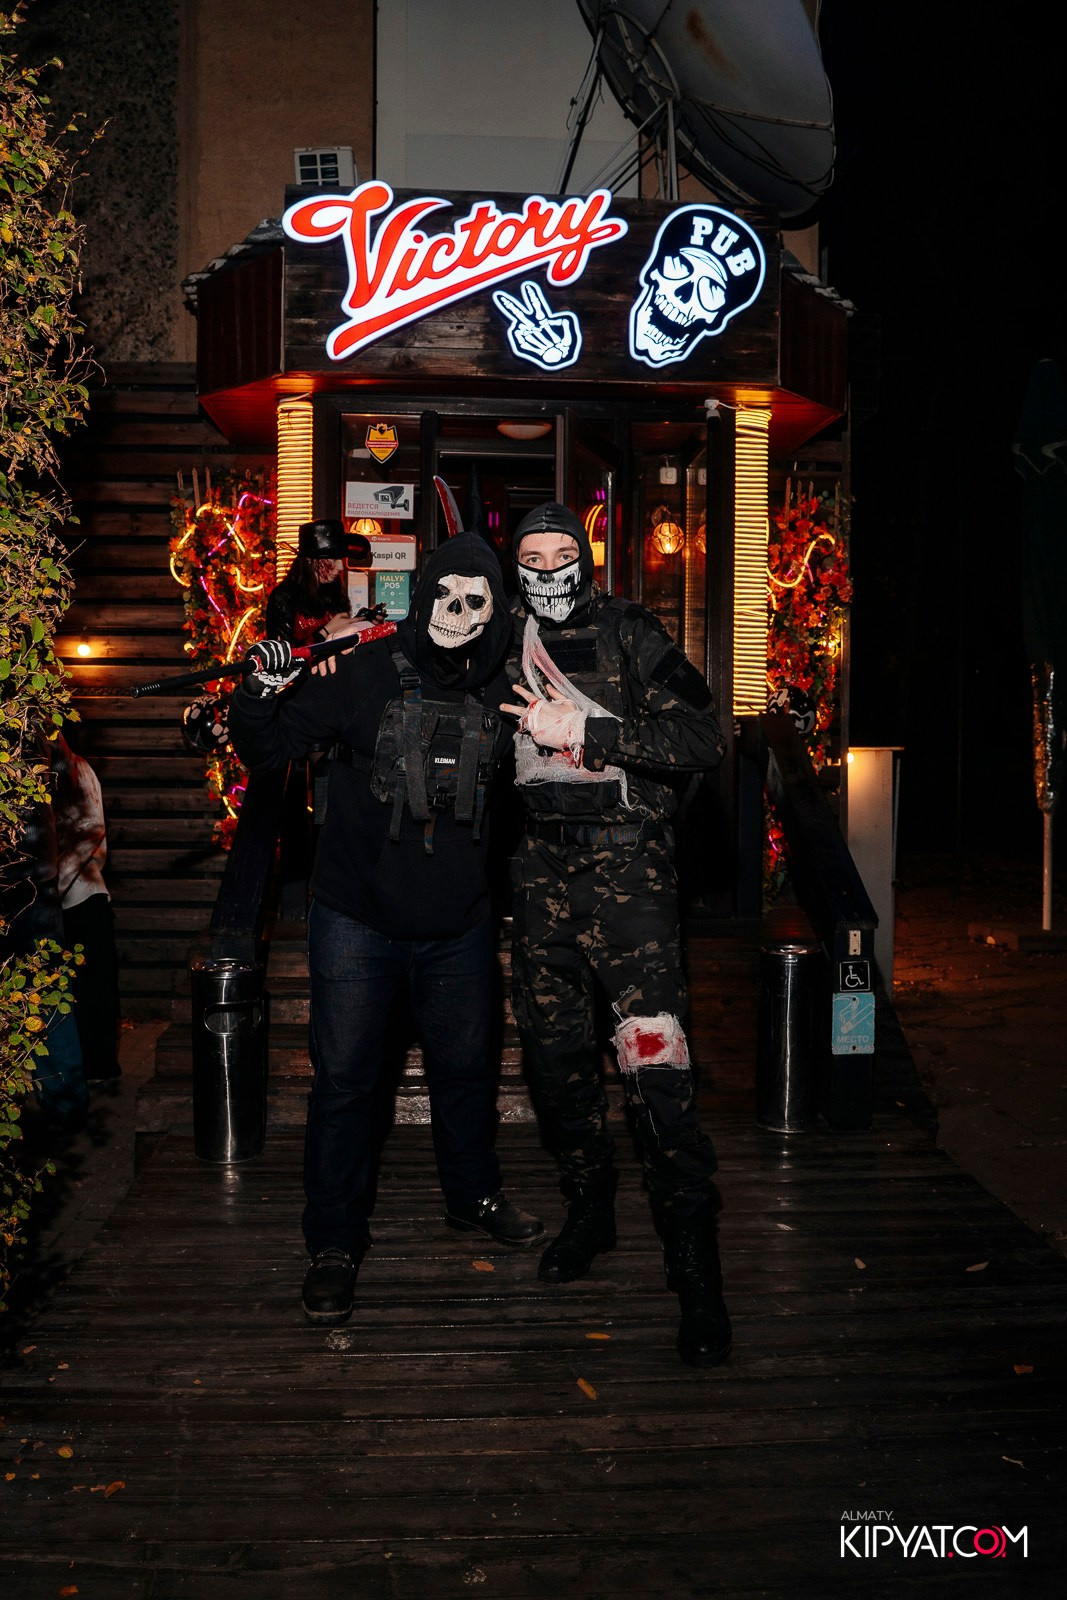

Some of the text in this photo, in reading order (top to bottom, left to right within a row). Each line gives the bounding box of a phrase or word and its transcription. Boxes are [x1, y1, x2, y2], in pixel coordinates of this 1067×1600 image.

[690, 216, 757, 278] PUB
[288, 183, 622, 358] Victory
[347, 502, 379, 510] ВЕДЕТСЯ
[371, 552, 407, 560] Kaspi QR
[836, 1035, 869, 1043] МЕСТО
